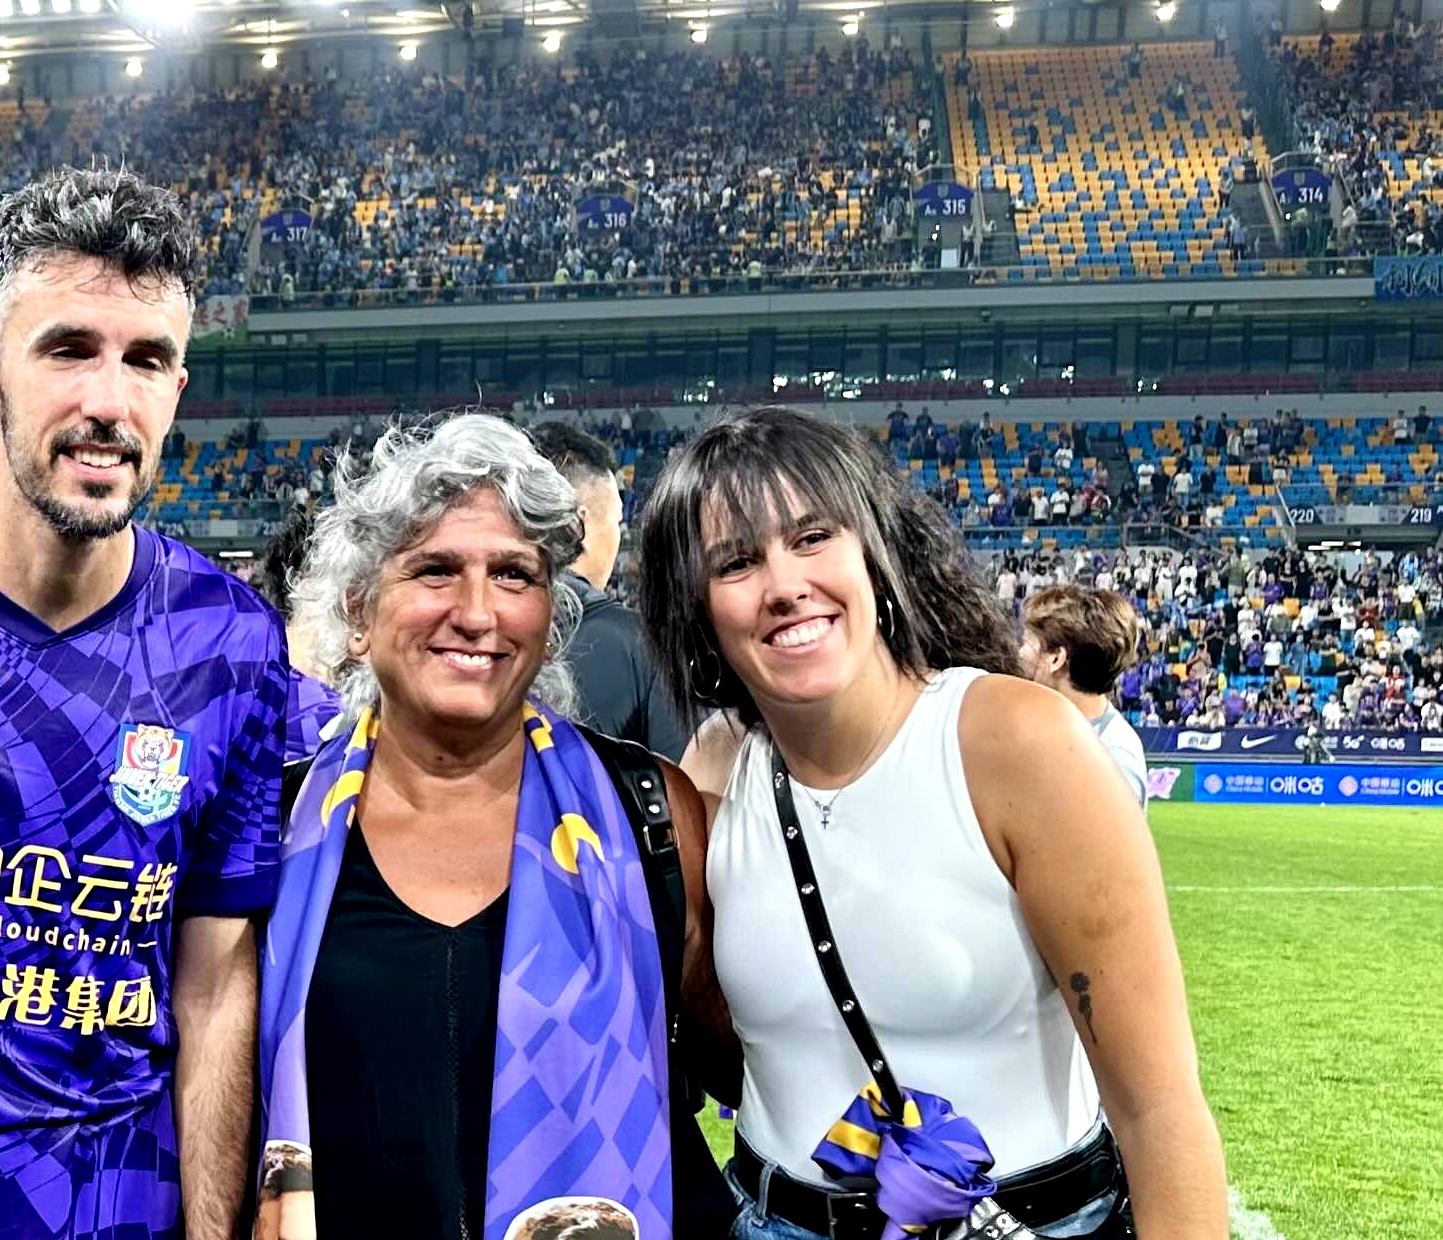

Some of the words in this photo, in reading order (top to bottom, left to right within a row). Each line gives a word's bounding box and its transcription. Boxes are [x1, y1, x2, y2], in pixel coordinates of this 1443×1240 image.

[1298, 186, 1323, 204] 314
[942, 198, 966, 215] 315
[604, 212, 627, 229] 316
[286, 226, 308, 242] 317
